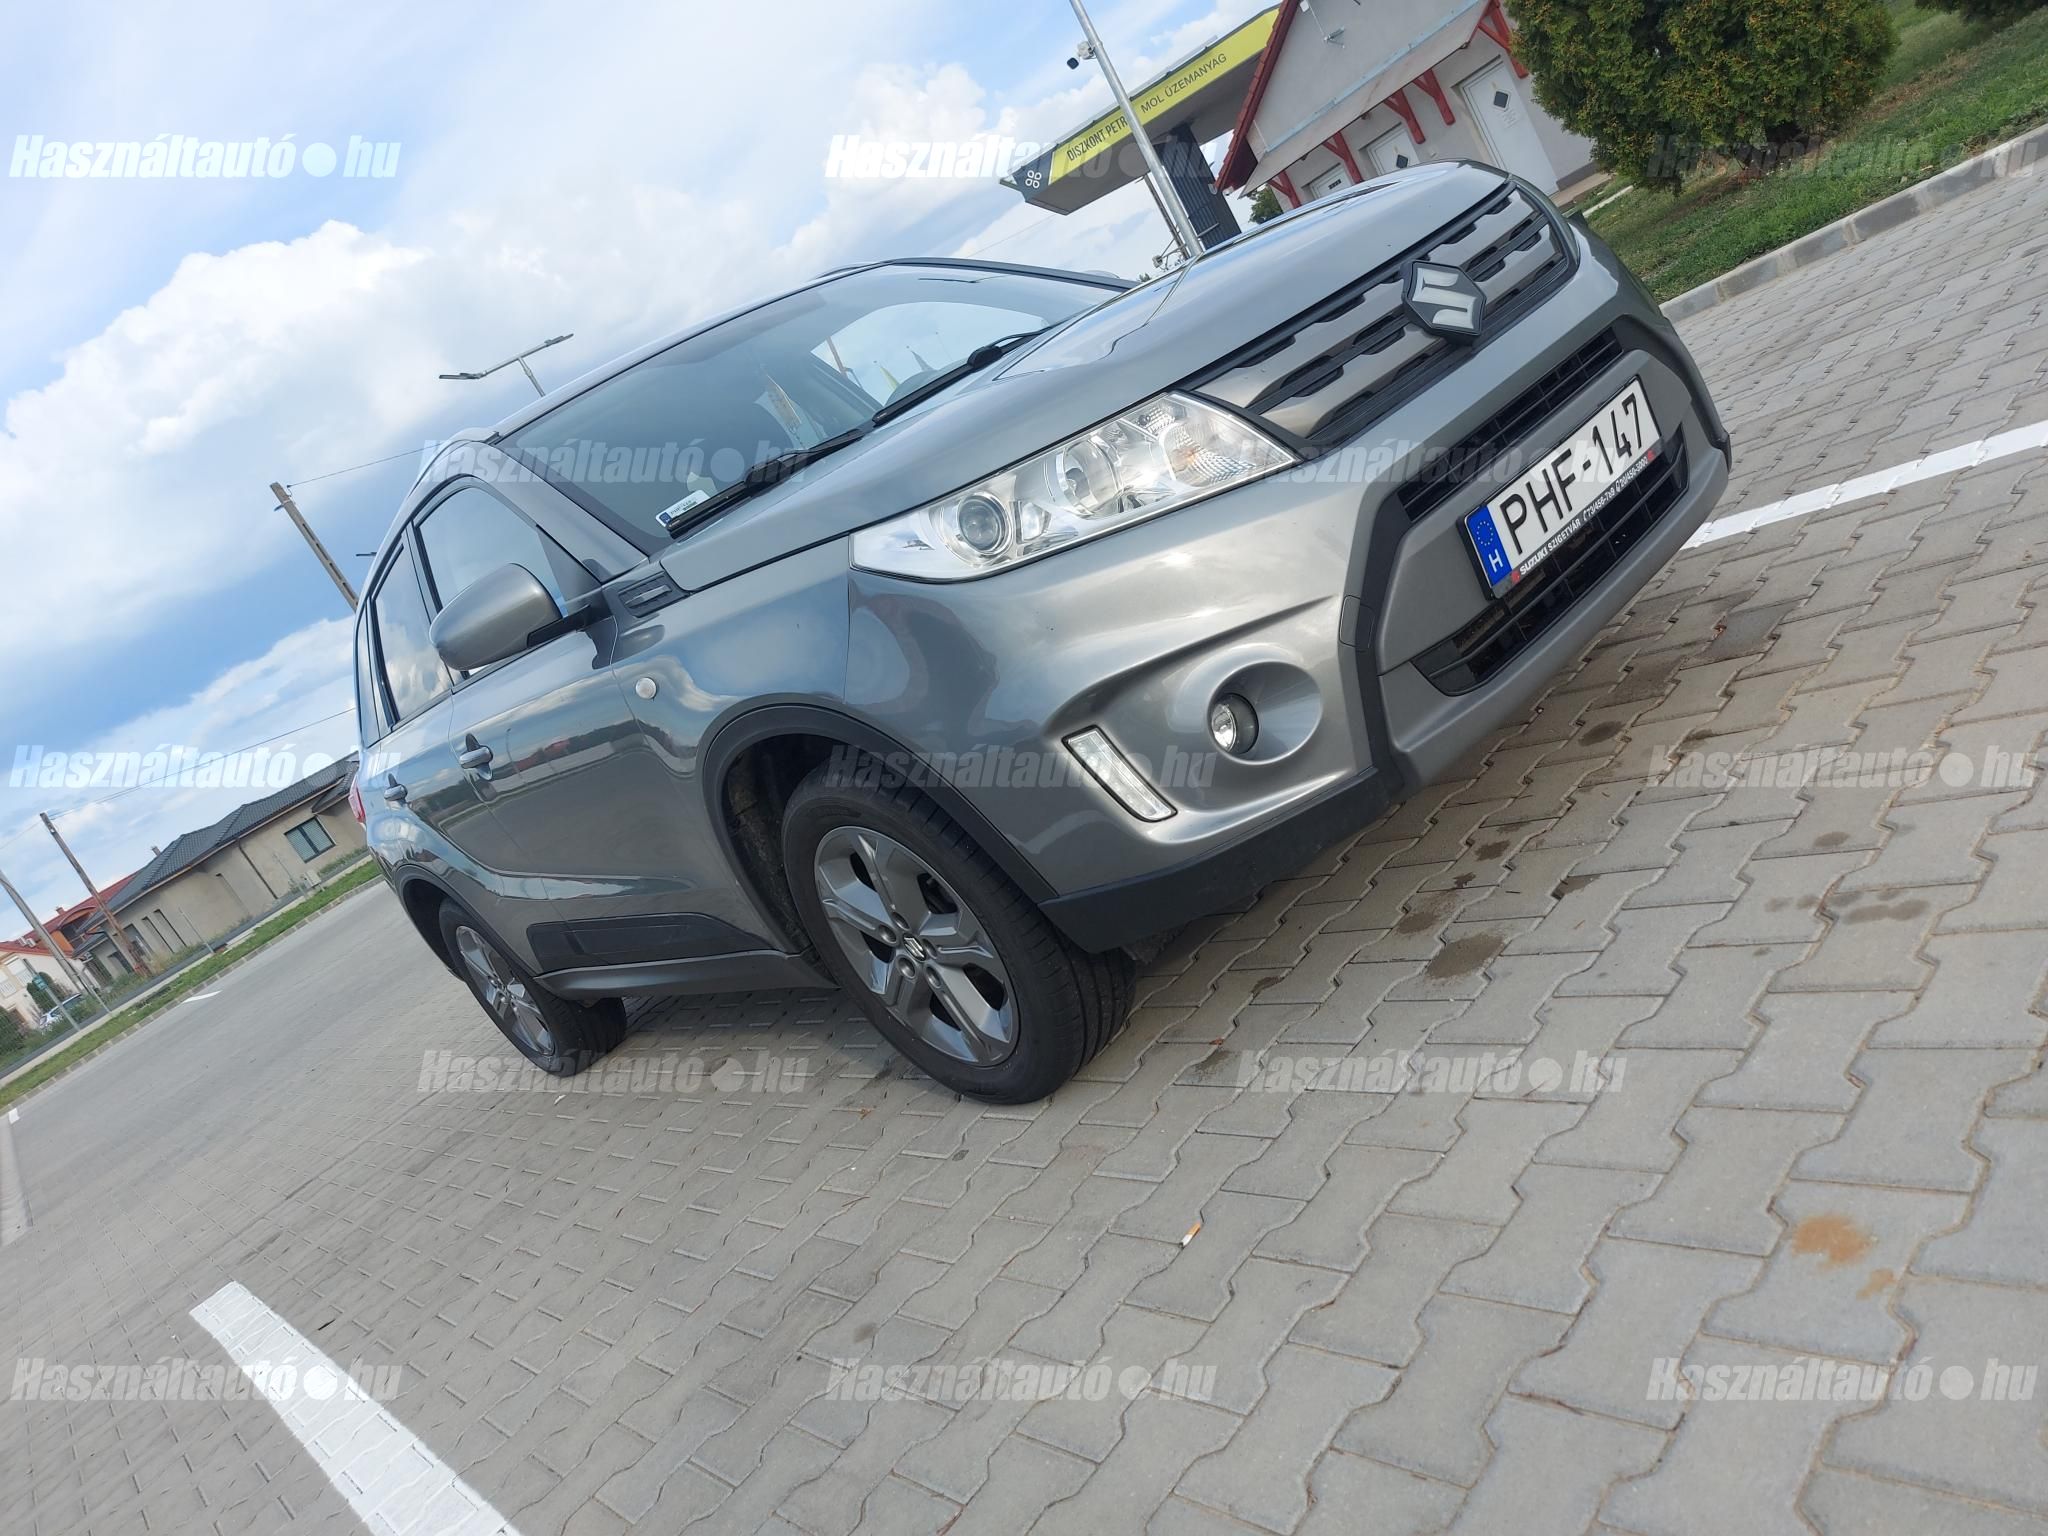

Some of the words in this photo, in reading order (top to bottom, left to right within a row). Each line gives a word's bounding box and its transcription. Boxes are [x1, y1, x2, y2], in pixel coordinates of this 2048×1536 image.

[1067, 131, 1106, 161] DISZKONT
[1140, 95, 1165, 114] MOL
[1164, 53, 1227, 98] ÜZEMANYAG
[1499, 392, 1642, 555] PHF-147
[1489, 550, 1503, 572] H
[1520, 546, 1548, 575] SUZUKI
[1547, 518, 1581, 551] SZIGETVÁR
